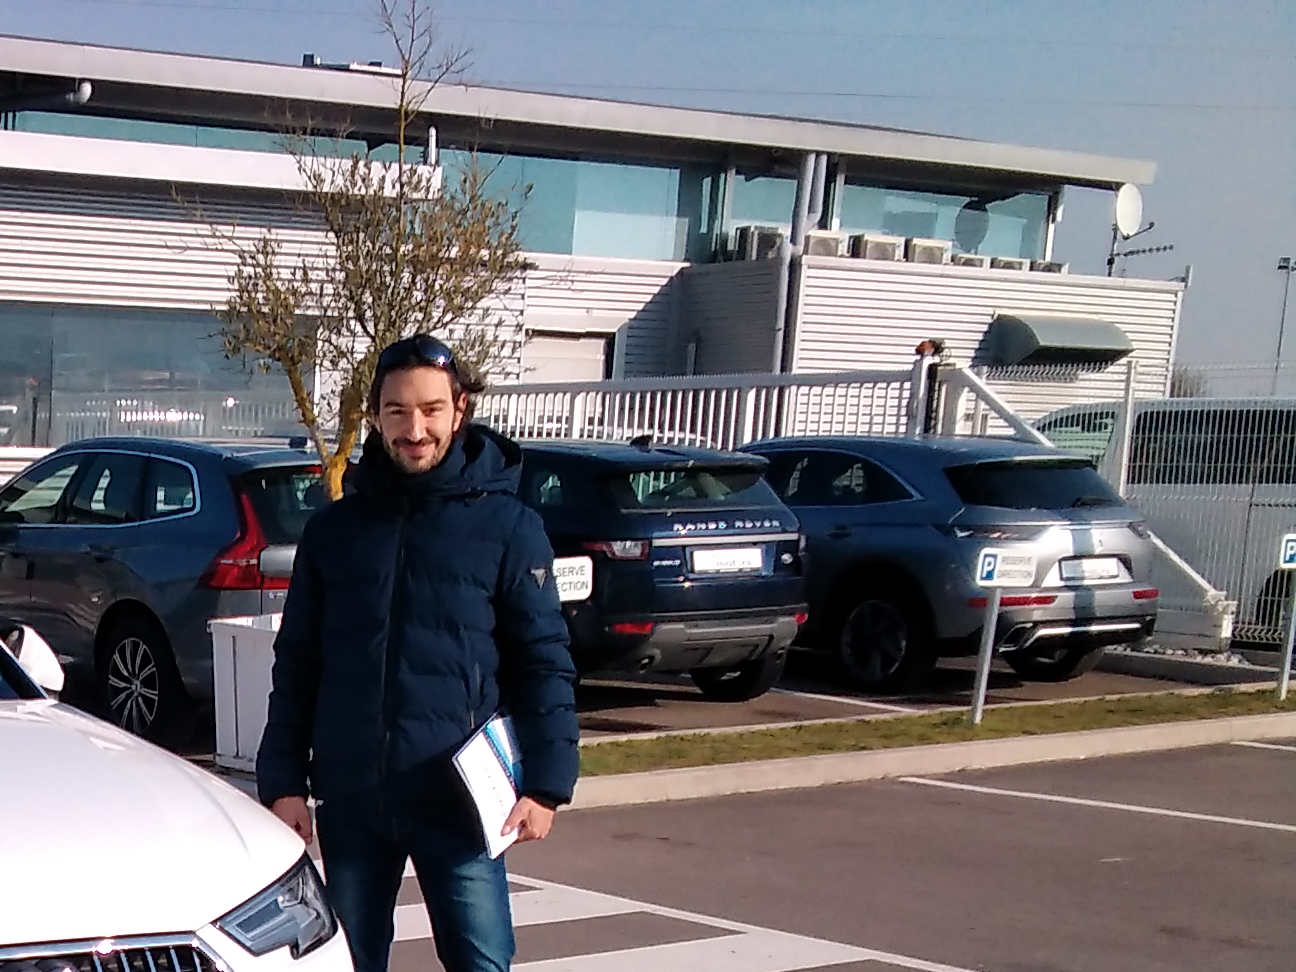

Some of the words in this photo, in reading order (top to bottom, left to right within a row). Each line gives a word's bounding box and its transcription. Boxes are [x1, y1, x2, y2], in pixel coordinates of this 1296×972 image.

[556, 565, 586, 577] SERVE
[982, 556, 995, 578] P
[557, 580, 589, 592] ECTION
